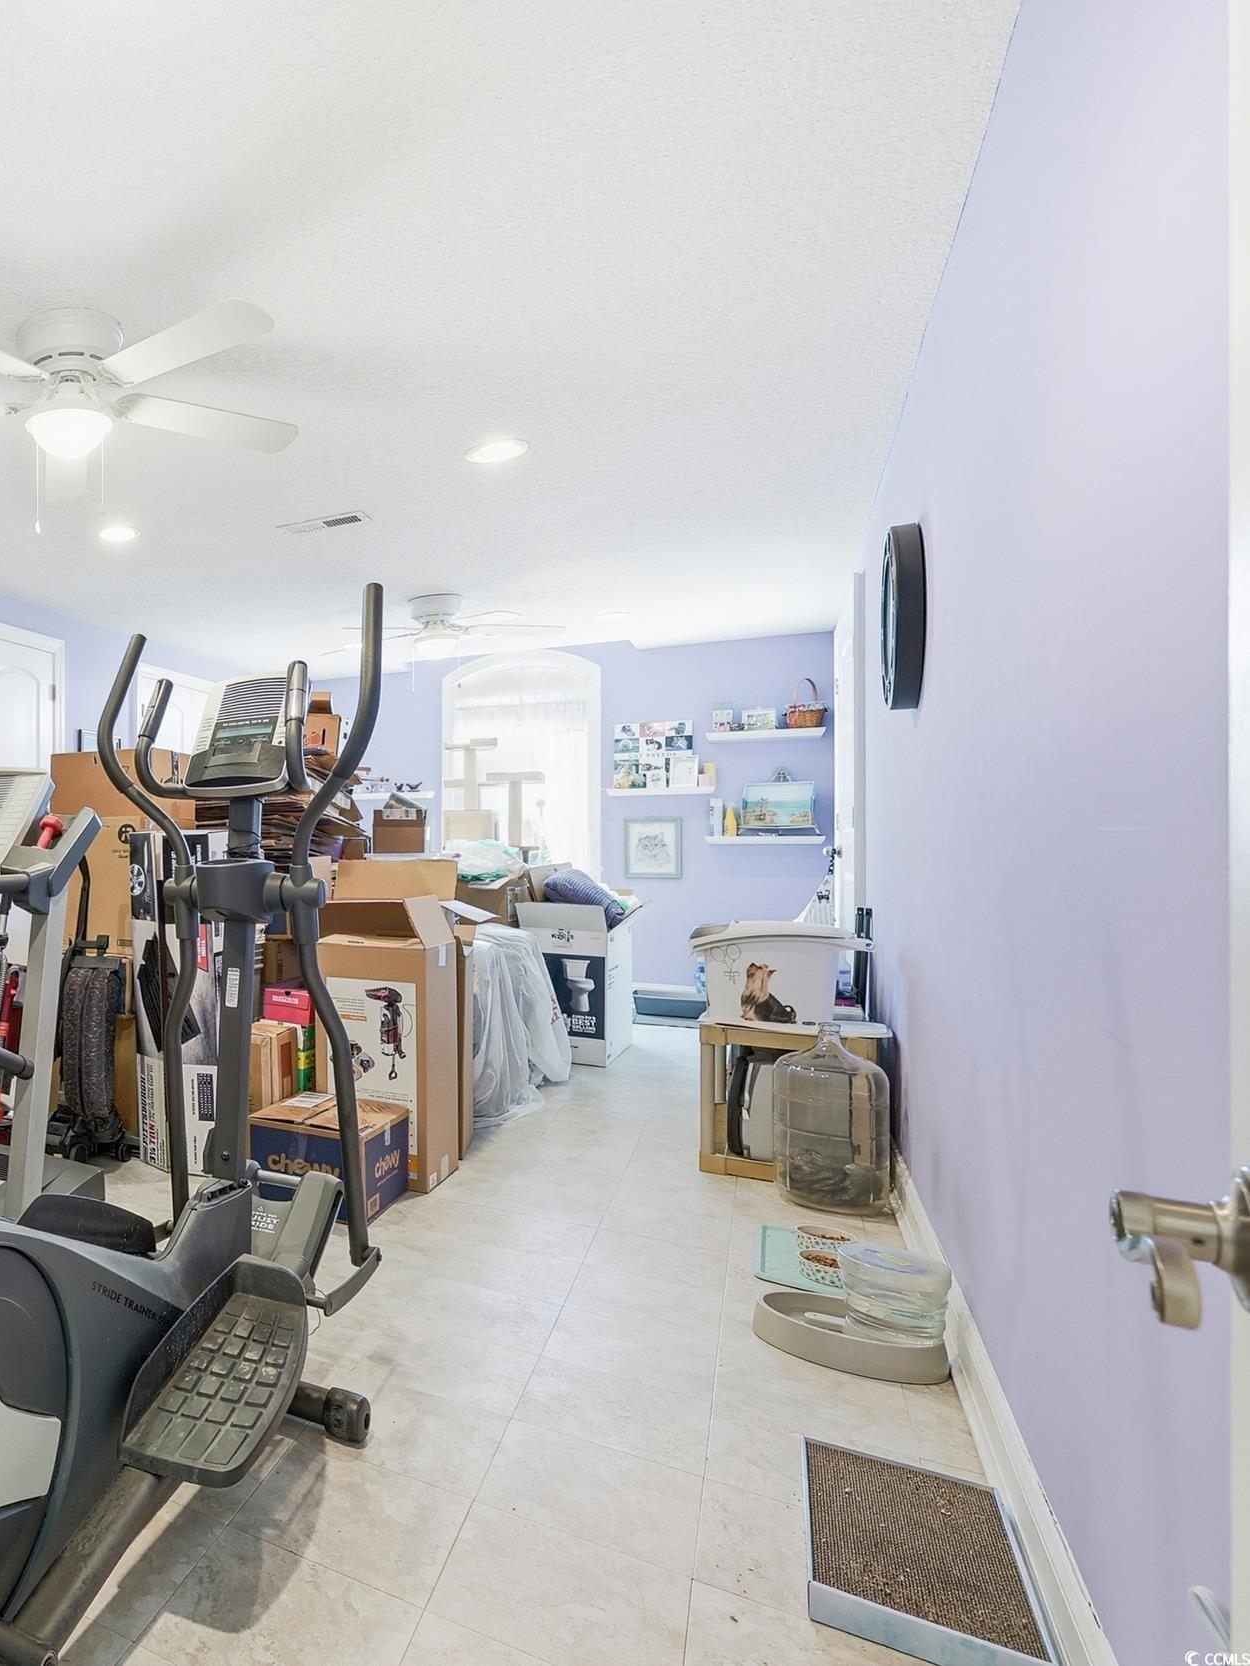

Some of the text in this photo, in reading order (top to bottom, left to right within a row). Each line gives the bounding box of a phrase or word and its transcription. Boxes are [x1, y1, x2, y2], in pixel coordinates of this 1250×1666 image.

[374, 1149, 400, 1178] chewy
[91, 1280, 122, 1304] STRIDE
[123, 1296, 157, 1321] TRAINER
